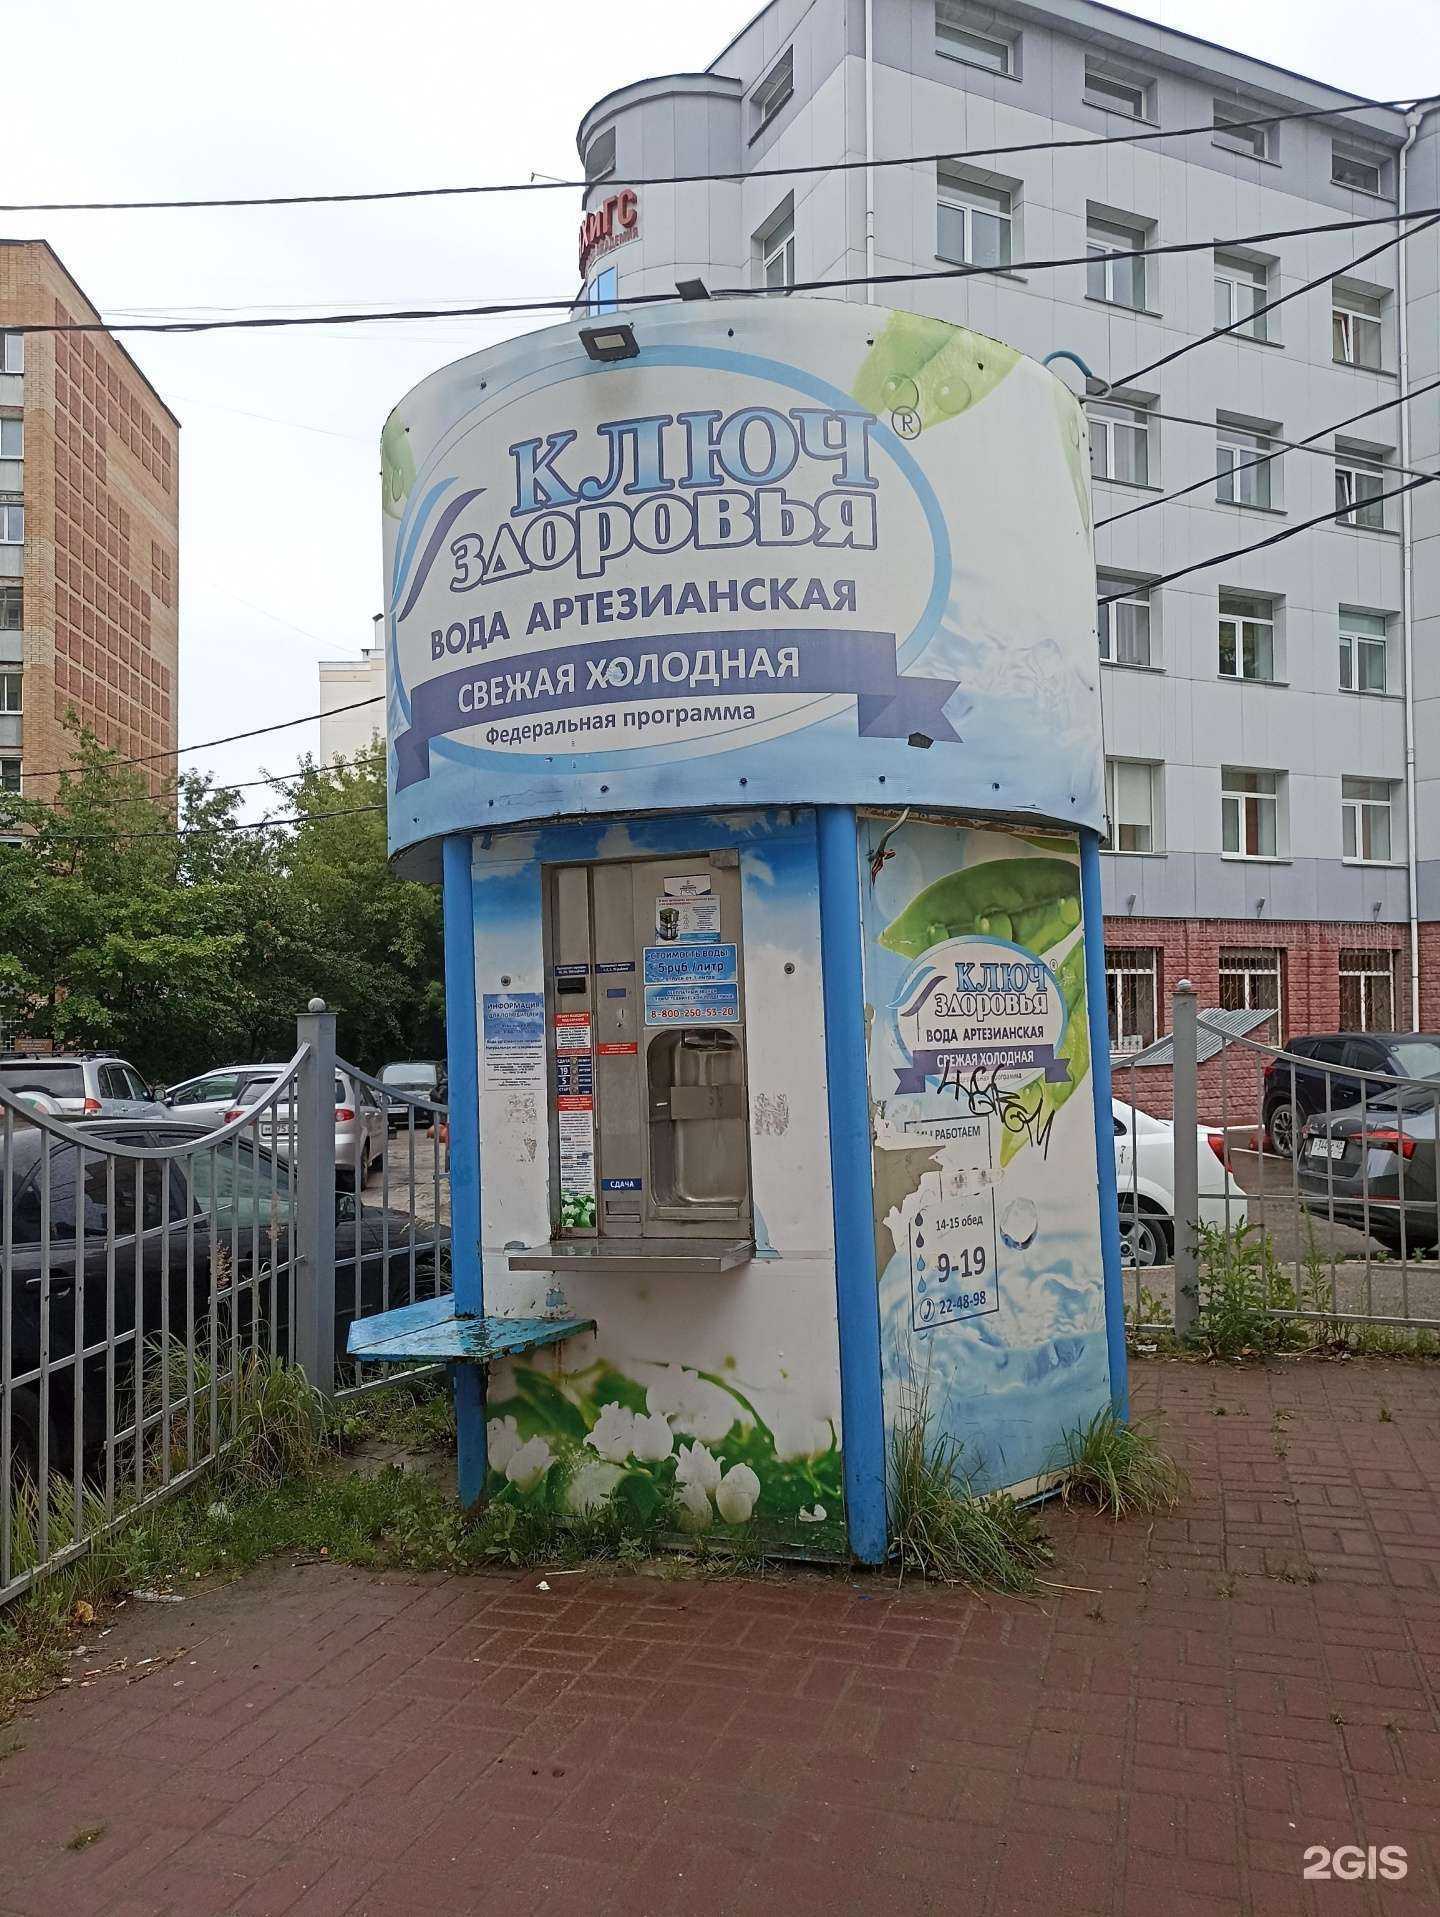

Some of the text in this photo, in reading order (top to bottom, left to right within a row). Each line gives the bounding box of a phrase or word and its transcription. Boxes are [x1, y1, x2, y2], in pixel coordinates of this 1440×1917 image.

[510, 406, 879, 518] КЛЮЧ
[449, 488, 878, 593] ЗДОРОВЬЯ
[431, 577, 857, 662] ВОДА АРТЕЗИАНСКАЯ
[458, 646, 800, 713] СВЕЖАЯ ХОЛОДНАЯ
[486, 702, 756, 745] Федеральная программа
[955, 963, 1048, 992] КЛЮЧ
[935, 993, 1049, 1022] ЗДОРОВЬЯ
[926, 1025, 1044, 1043] ВОДА АРТЕЗИАНСКАЯ
[980, 1050, 1034, 1066] ХОЛОДНАЯ
[935, 1125, 981, 1140] РАБОТАЕМ
[610, 1181, 635, 1189] СДАЧА
[936, 1214, 984, 1231] 14-15 обед
[937, 1246, 986, 1283] 9-19
[940, 1290, 986, 1314] 22-48-98
